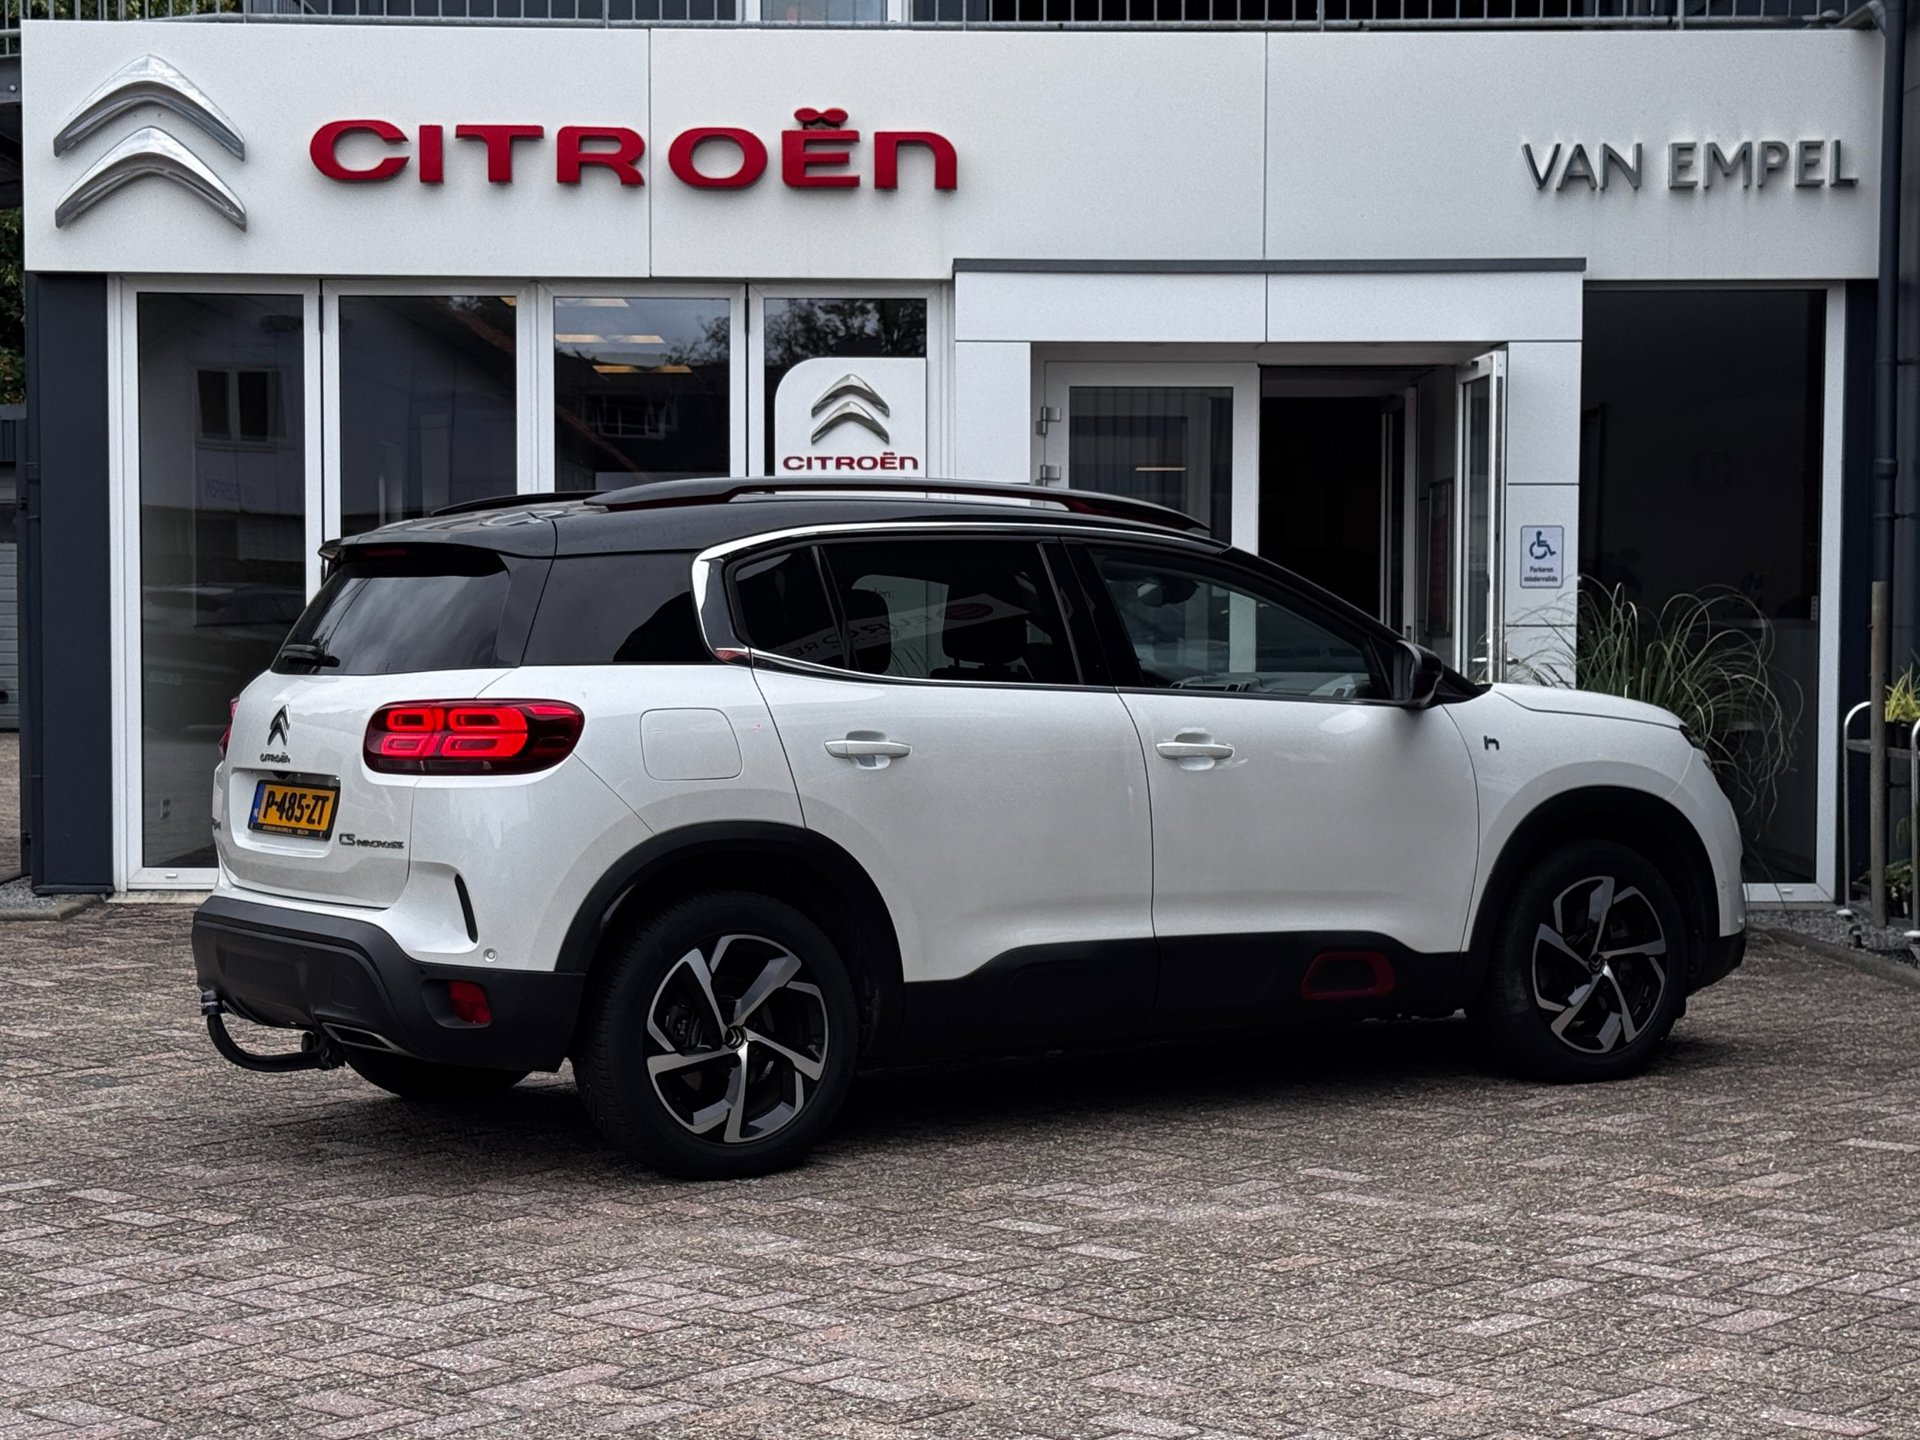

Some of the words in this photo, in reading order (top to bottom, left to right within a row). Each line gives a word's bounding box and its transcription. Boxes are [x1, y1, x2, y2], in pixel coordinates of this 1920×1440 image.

[1520, 142, 1643, 191] VAN
[1667, 139, 1860, 190] EMPEL
[262, 790, 330, 826] P-485-ZT
